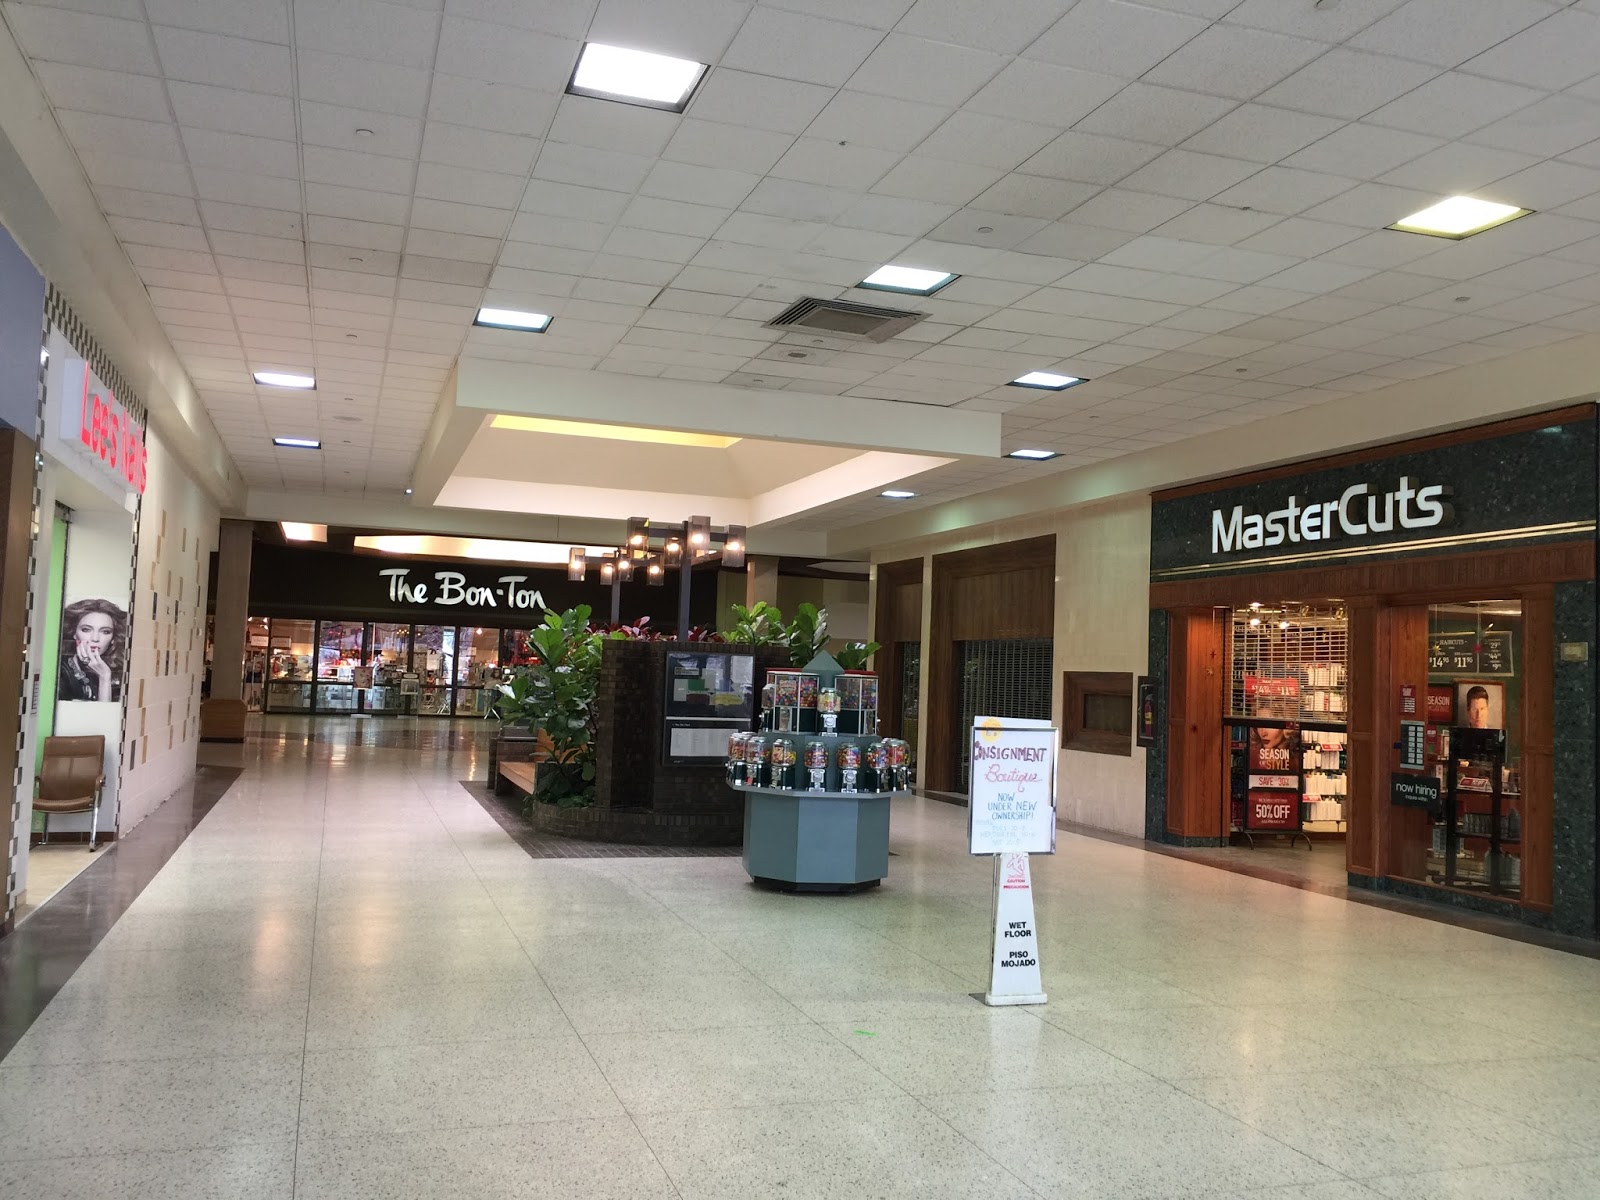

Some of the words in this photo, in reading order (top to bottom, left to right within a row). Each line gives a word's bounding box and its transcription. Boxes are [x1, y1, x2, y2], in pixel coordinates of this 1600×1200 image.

[81, 361, 119, 469] Lee's
[1211, 476, 1444, 554] MasterCuts
[379, 568, 429, 603] The
[1427, 695, 1450, 706] SEASON
[1259, 748, 1290, 760] SEASON
[1266, 760, 1290, 770] STYLE
[984, 763, 1043, 793] Boutique
[1258, 776, 1273, 786] SAVE
[1395, 783, 1414, 793] now
[1415, 784, 1437, 799] hiring
[997, 792, 1015, 801] NOW
[987, 802, 1012, 811] UNDER
[1015, 801, 1037, 811] NEW
[991, 811, 1034, 820] OWNERSHIP!
[1255, 804, 1273, 818] 50%
[1273, 805, 1290, 819] OFF
[1009, 921, 1027, 929] WET
[1004, 930, 1032, 938] FLOOR
[1009, 950, 1029, 958] PISO
[1001, 959, 1036, 967] MOJADO
